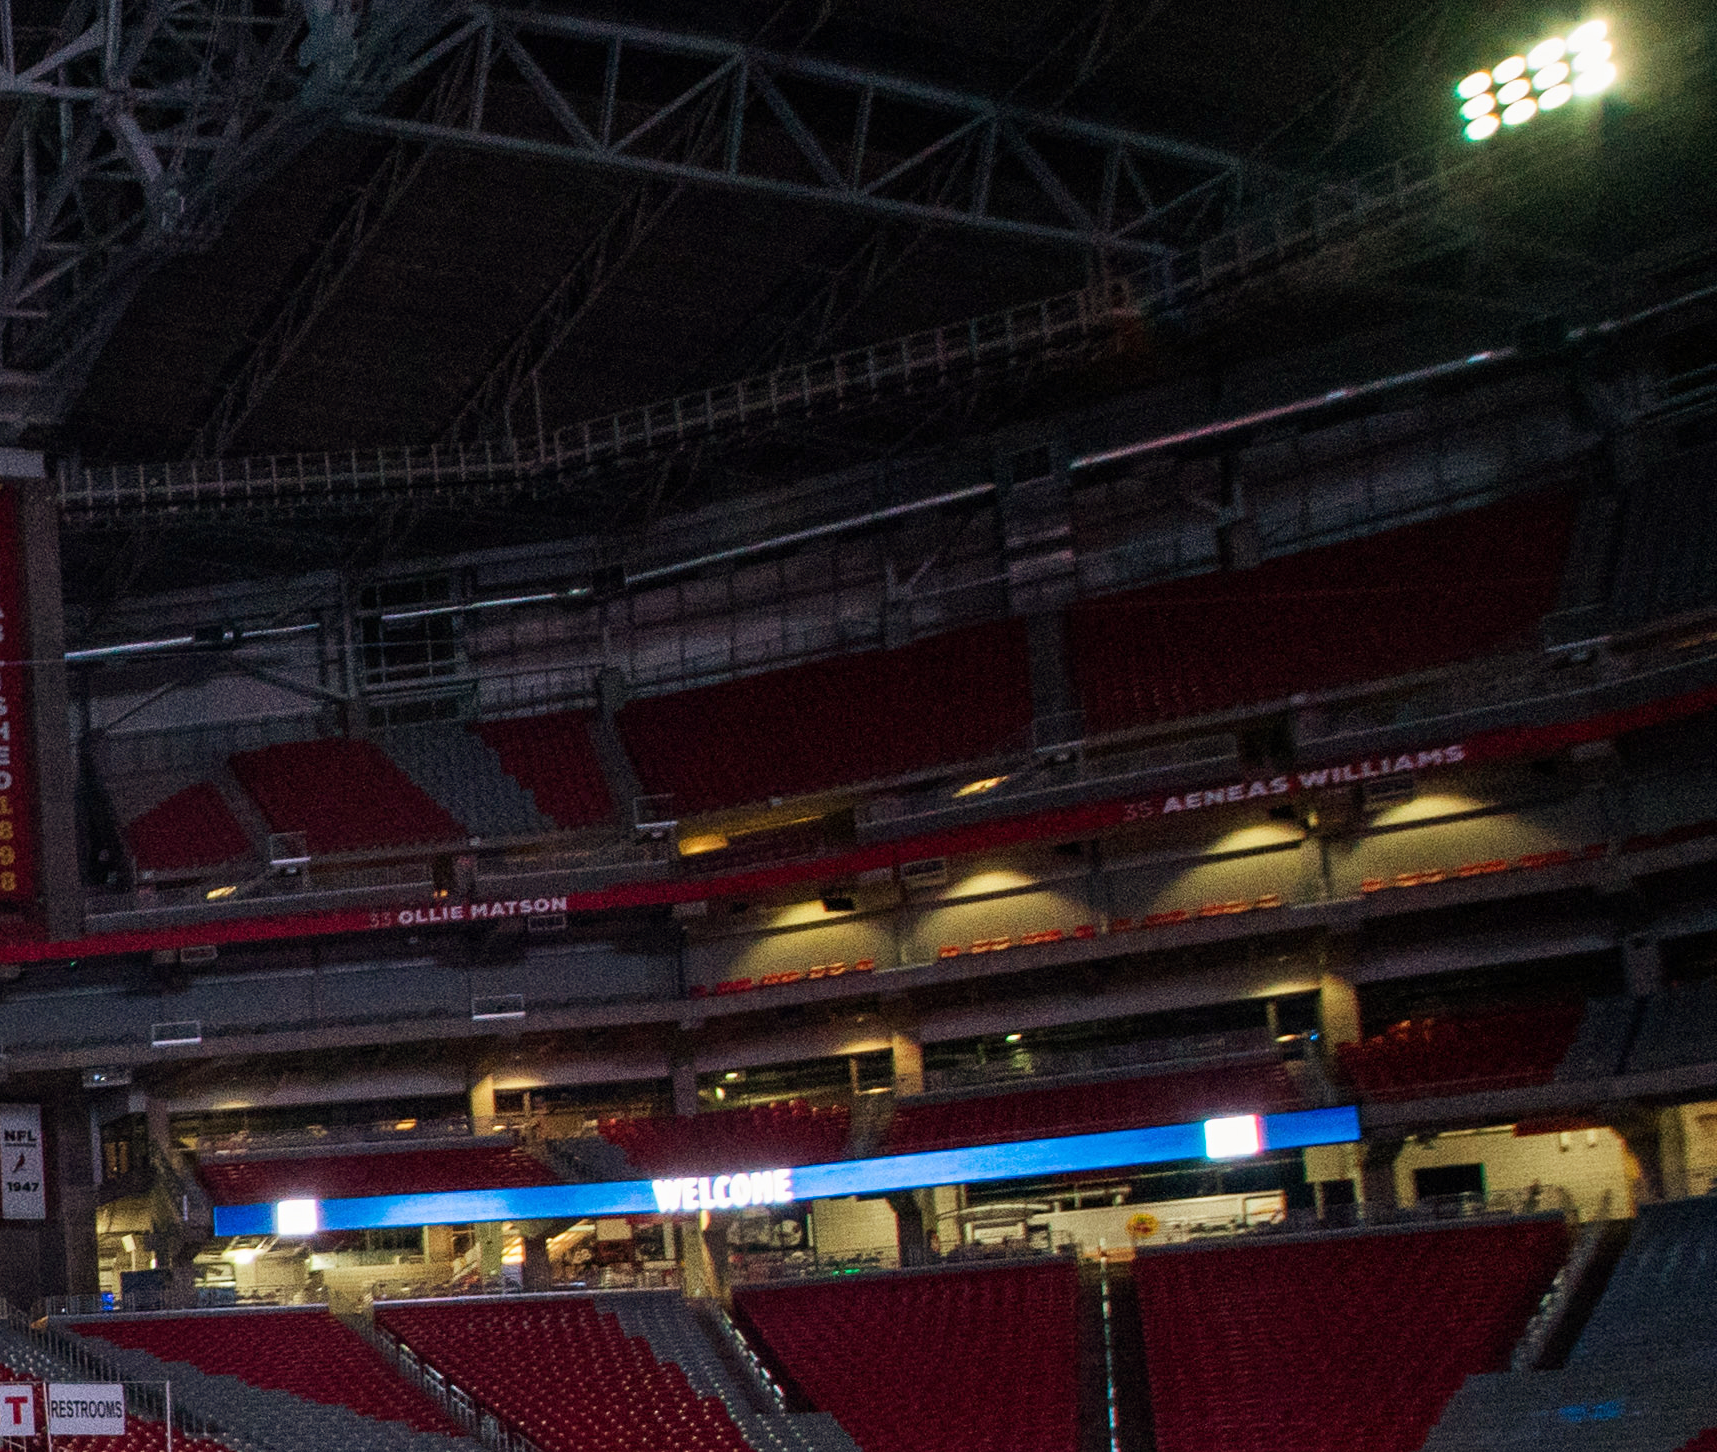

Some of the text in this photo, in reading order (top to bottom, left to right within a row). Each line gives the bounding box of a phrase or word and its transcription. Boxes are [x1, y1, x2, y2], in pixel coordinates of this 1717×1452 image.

[1162, 775, 1290, 814] AENEAS
[1298, 744, 1466, 789] WILLIAMS
[398, 905, 464, 925] OLLIE
[471, 897, 567, 918] MATSON
[4, 1131, 36, 1141] NFL
[7, 1182, 39, 1192] 1947
[652, 1168, 794, 1213] WELCOME
[51, 1400, 123, 1418] RESTROOMS
